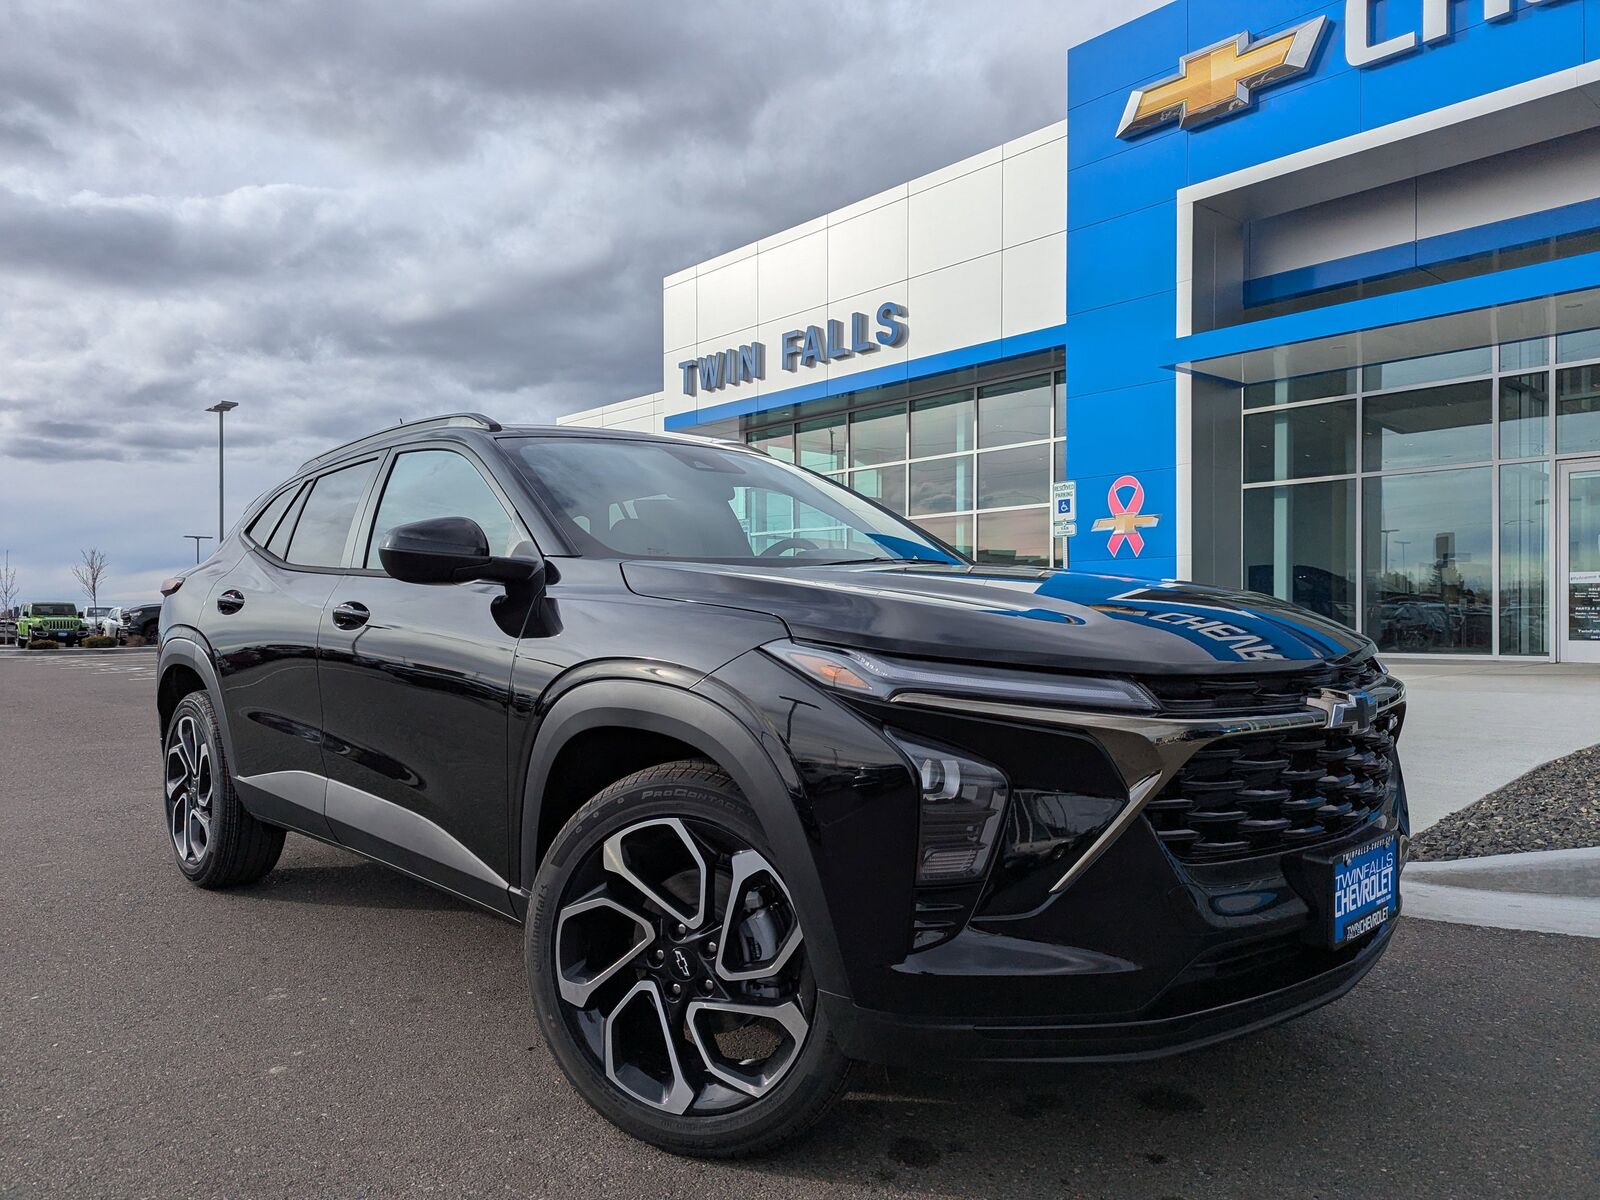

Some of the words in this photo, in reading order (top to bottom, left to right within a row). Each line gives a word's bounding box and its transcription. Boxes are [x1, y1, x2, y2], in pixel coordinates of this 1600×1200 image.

[678, 342, 766, 397] TWIN
[782, 301, 909, 373] FALLS
[1334, 867, 1393, 918] CHEVROLET
[1360, 906, 1389, 934] CHEVROLET
